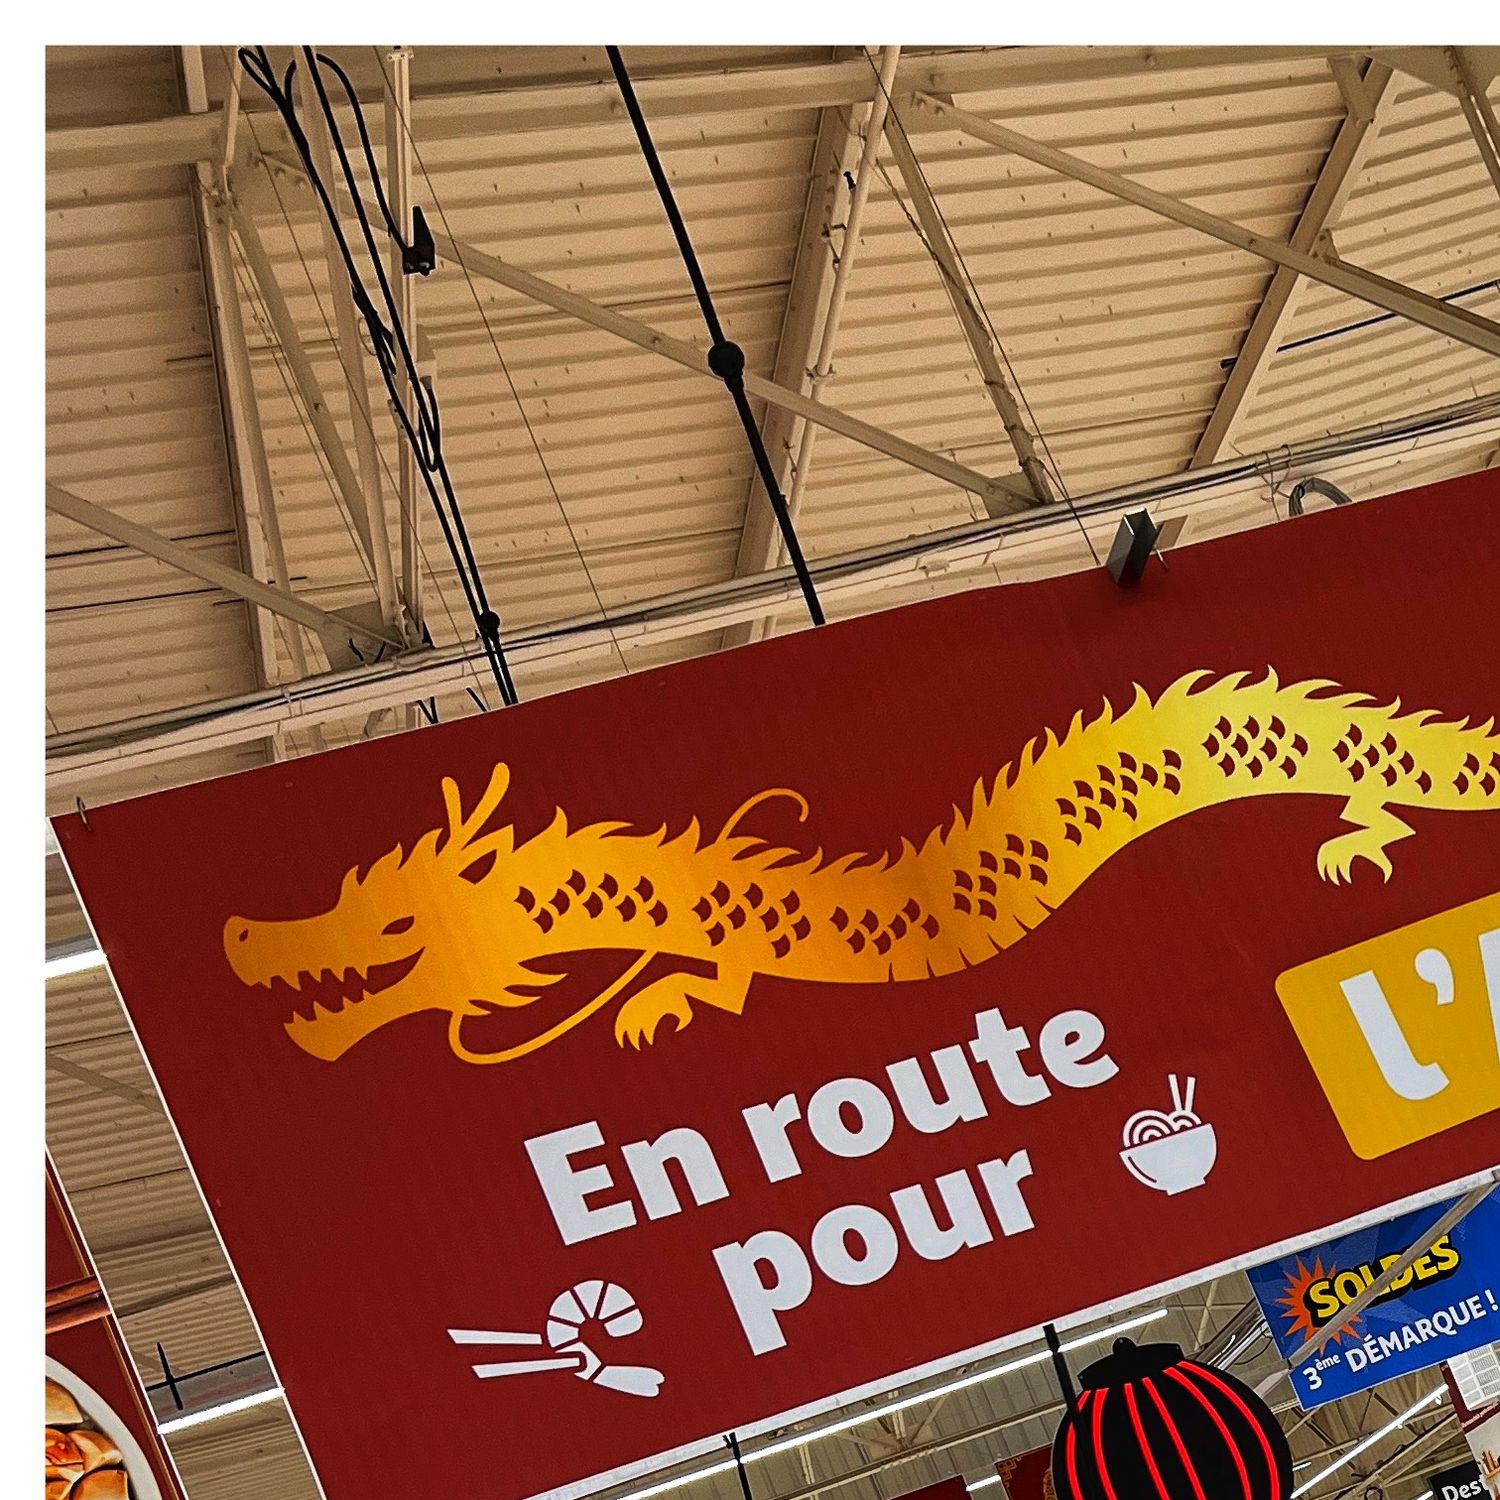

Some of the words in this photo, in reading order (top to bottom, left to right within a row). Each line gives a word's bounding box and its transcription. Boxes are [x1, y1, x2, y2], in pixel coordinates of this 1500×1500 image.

[524, 1121, 730, 1245] En
[741, 1007, 1119, 1184] route
[712, 1148, 1036, 1356] pour
[1302, 1352, 1341, 1391] 3ème
[1346, 1299, 1486, 1374] DÉMARQUE
[1486, 1289, 1500, 1311] !
